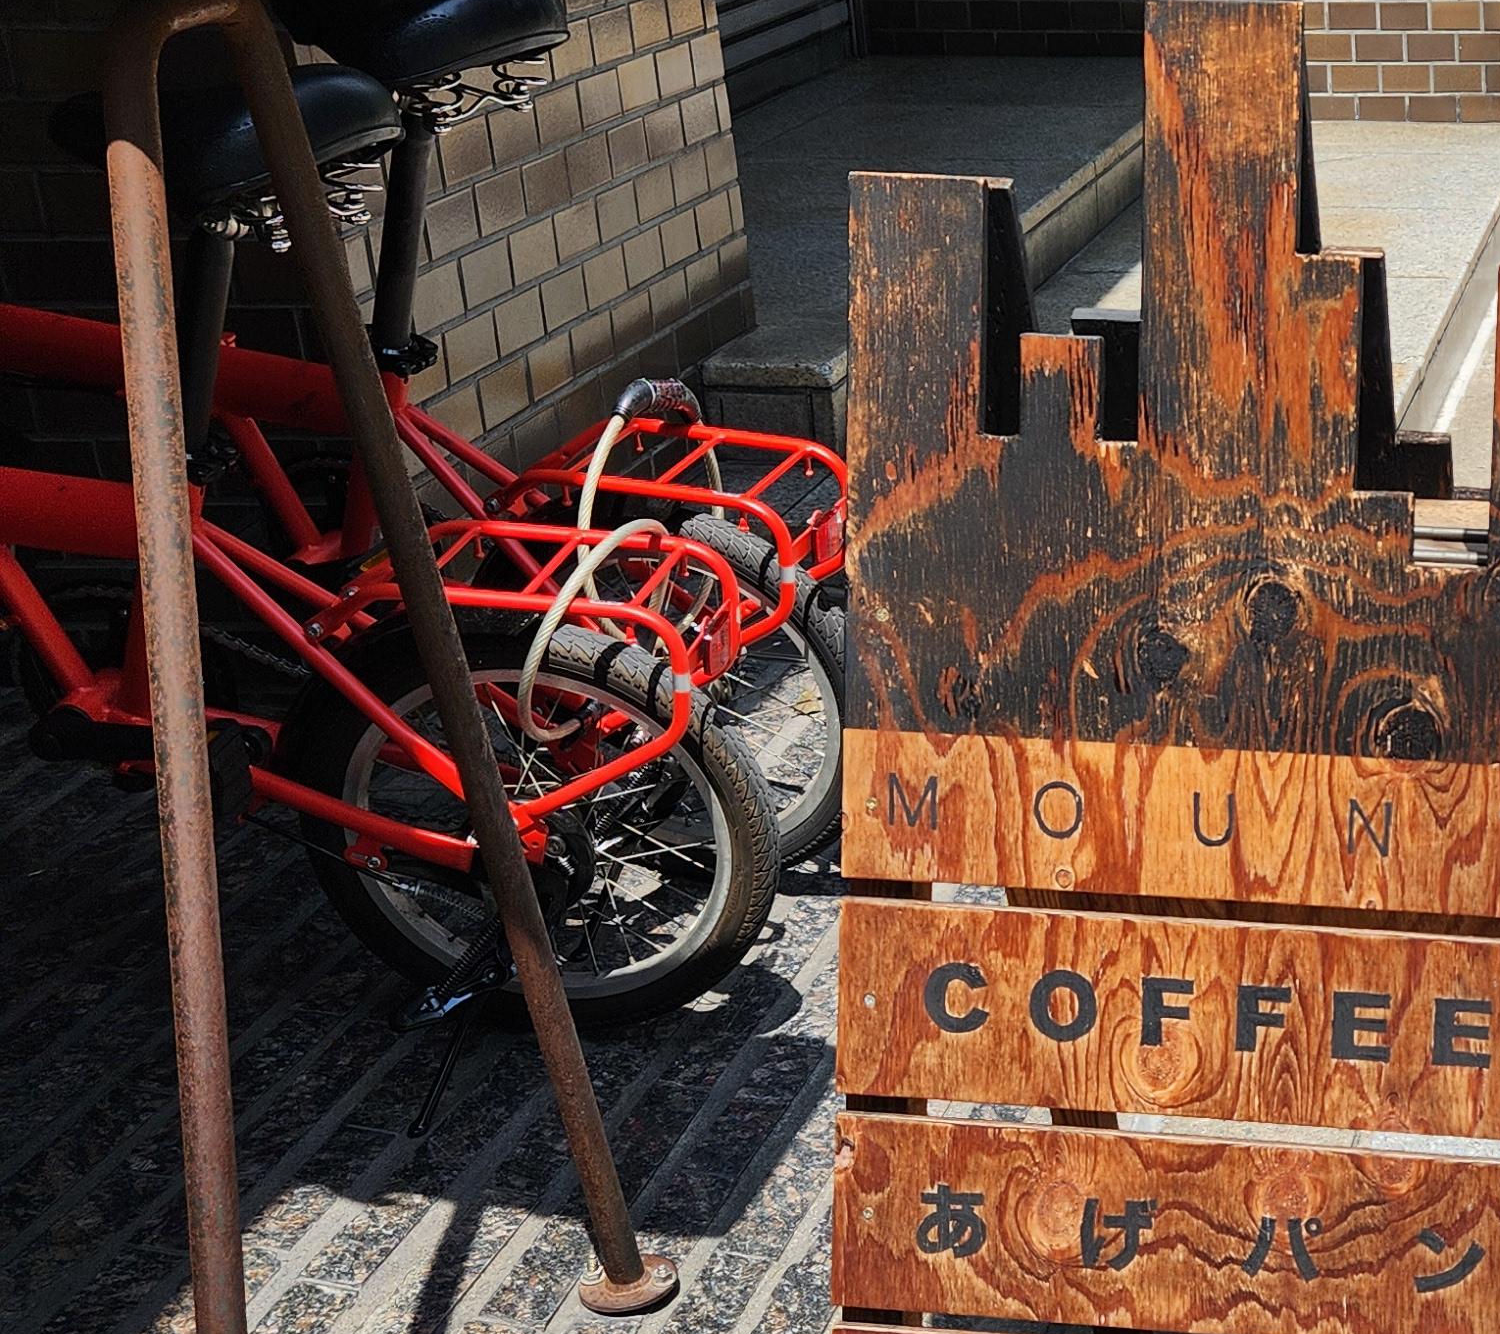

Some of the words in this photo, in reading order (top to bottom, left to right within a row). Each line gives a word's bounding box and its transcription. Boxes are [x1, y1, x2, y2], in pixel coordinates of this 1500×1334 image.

[923, 961, 1495, 1070] COFFEE
[916, 1183, 1487, 1295] あげパン
